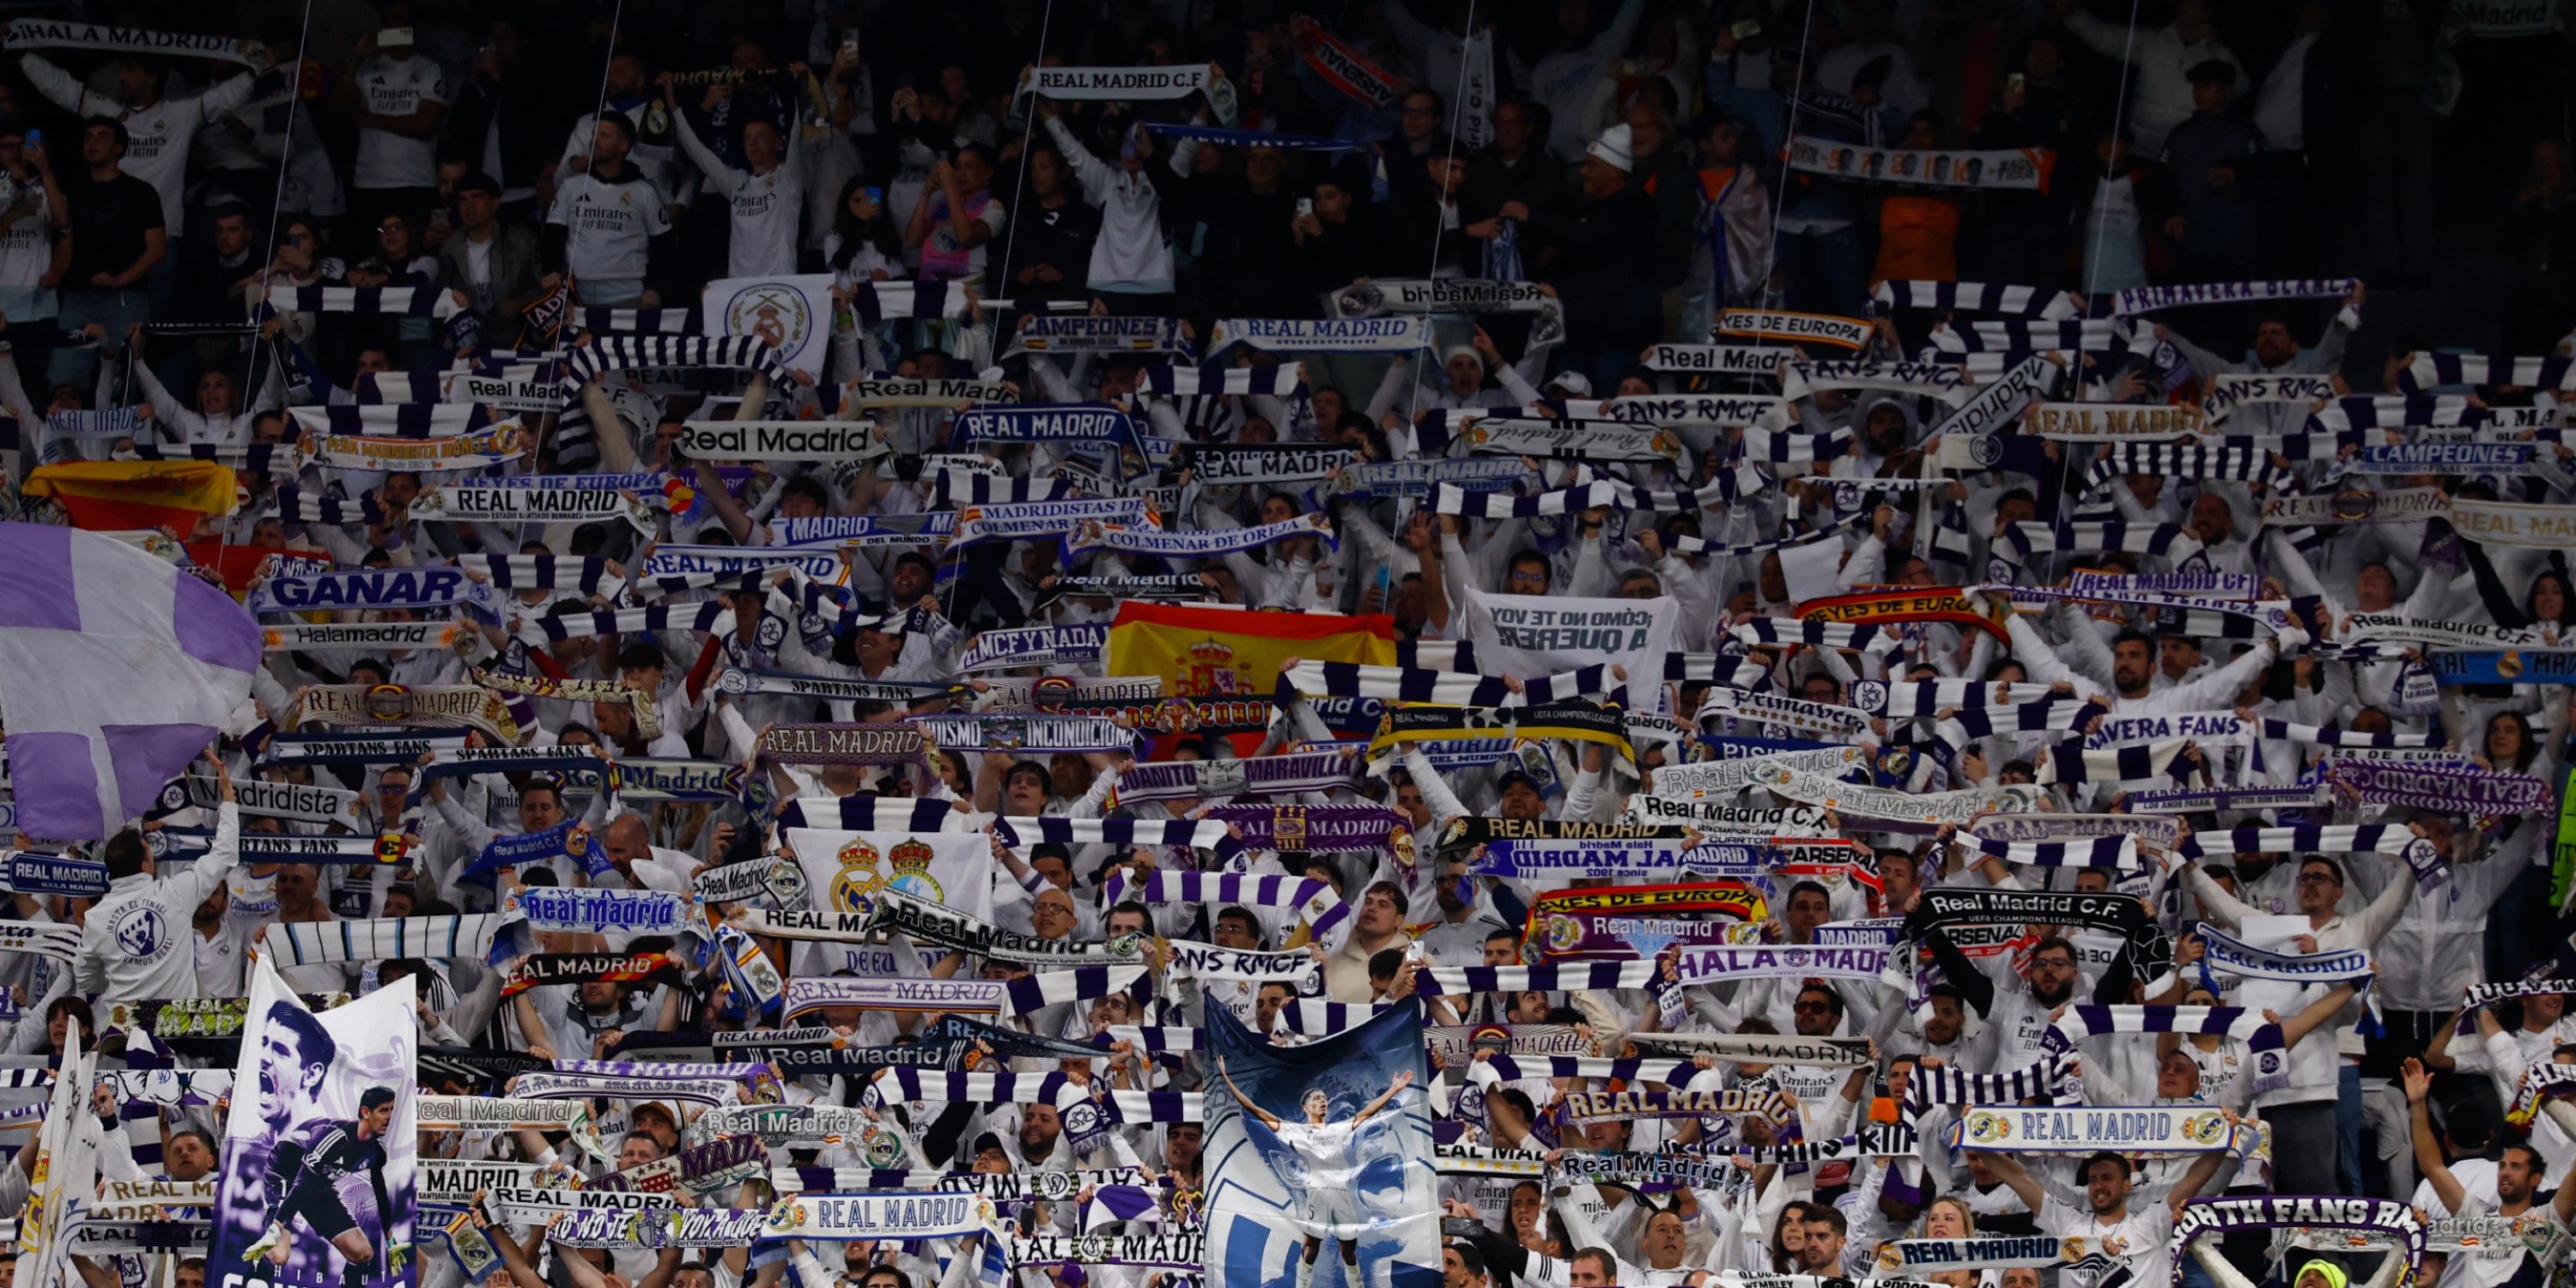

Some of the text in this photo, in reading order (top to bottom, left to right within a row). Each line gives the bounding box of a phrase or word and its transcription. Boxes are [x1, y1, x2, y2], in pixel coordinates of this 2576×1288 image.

[19, 24, 234, 52] ¡HALA MADRID!
[1040, 75, 1088, 88] REAL
[1092, 74, 1170, 88] MADRID
[1319, 41, 1394, 106] ARSENAL
[370, 87, 420, 100] Emirates
[574, 206, 632, 222] Emirates
[1022, 316, 1158, 336] CAMPEONES
[1249, 319, 1408, 336] REAL MADRID
[1613, 401, 1774, 423] FANS RMCF
[969, 415, 1115, 437] REAL MADRID
[683, 428, 868, 453] Real Madrid
[2372, 444, 2523, 464] CAMPEONES
[459, 490, 618, 512] REAL MADRID
[984, 501, 1114, 519] MADRIDISTAS
[2269, 497, 2326, 517] REAL
[791, 515, 871, 542] MADRID
[971, 519, 1073, 535] COLMENAR
[2452, 513, 2522, 535] REAL
[1109, 520, 1300, 551] COLMENAR DE OREJA
[646, 556, 835, 579] REAL MADRID
[272, 570, 462, 609] GANAR
[2082, 574, 2128, 591] REAL
[2137, 573, 2211, 592] MADRID
[2224, 574, 2248, 590] CF
[2351, 613, 2403, 629] Real
[296, 625, 428, 645] Halamadrid
[1006, 651, 1092, 664] PRIMAVERA BLANCA
[793, 680, 914, 700] SPARTANS FANS
[309, 690, 480, 714] REAL MADRID
[1733, 689, 1866, 734] Primavera
[1394, 713, 1449, 724] REAL MADRID
[1534, 710, 1617, 723] UEFA CHAMPIONS LEAGUE
[304, 741, 431, 756] SPARTANS FANS
[766, 728, 921, 754] REAL MADRID
[457, 744, 584, 762] SPARTANS FANS
[1118, 752, 1351, 792] JUANITO MARAVILLA
[1802, 773, 1979, 818] Real Madrid
[2373, 773, 2472, 799] MADRID
[2482, 780, 2543, 804] REAL
[1489, 818, 1661, 839] REAL MADRID
[1716, 825, 1750, 835] CHAMPIONS
[494, 842, 515, 855] Real
[516, 840, 545, 853] Madrid
[1683, 845, 1749, 865] MADRID
[15, 862, 102, 884] REAL MADRID
[1686, 865, 1718, 874] SANTIAGO
[67, 884, 106, 892] MADRID
[126, 899, 142, 911] EL
[141, 897, 167, 915] FINAL!
[229, 897, 279, 912] Emirates
[526, 895, 675, 926] Real Madrid
[1931, 894, 2122, 919] Real Madrid C.F.
[766, 910, 830, 931] REAL
[896, 900, 1090, 956] Real Madrid
[1593, 918, 1712, 939] Real Madrid
[1969, 914, 1991, 923] UEFA
[1993, 915, 2044, 925] CHAMPIONS
[1820, 927, 1886, 945] MADRID
[123, 954, 154, 967] VAMOS
[1675, 948, 1891, 981] HALA MADR
[2263, 955, 2366, 975] MADRID
[788, 981, 1002, 1006] REAL MADRID
[753, 1029, 829, 1042] MADRID
[769, 1046, 943, 1066] Real Madrid
[1651, 1037, 1871, 1066] REAL MADRID
[1781, 1071, 1836, 1087] Emirates
[1566, 1090, 1789, 1128] REAL MADRID
[708, 1112, 851, 1133] Real Madrid
[2021, 1112, 2171, 1141] REAL MADRID
[1564, 1155, 1727, 1182] Real Madrid
[113, 1181, 185, 1200] REAL
[818, 1198, 968, 1227] REAL MADRID
[1903, 1236, 2058, 1265] REAL MADRID
